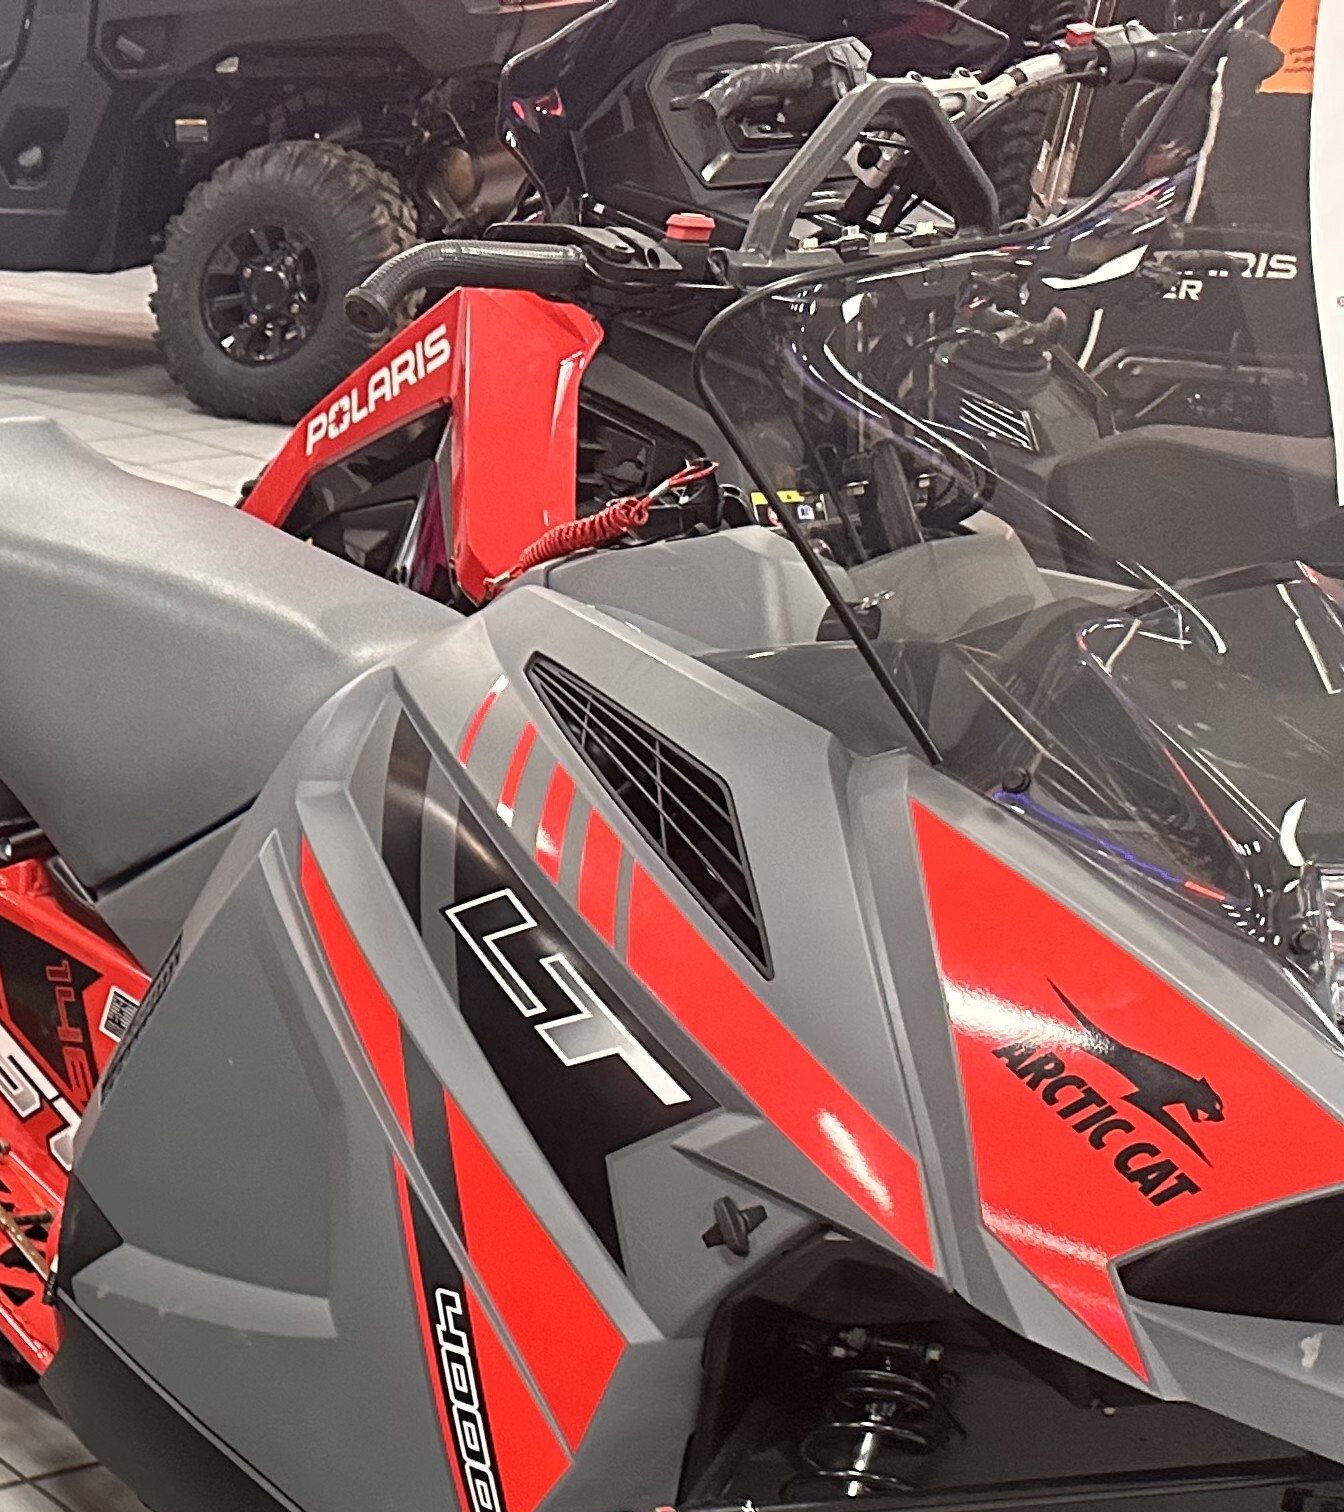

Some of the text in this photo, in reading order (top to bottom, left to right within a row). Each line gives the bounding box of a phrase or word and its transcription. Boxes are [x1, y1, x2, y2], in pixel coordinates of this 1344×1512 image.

[305, 322, 451, 457] POLARIS
[445, 888, 692, 1107] LT
[992, 1042, 1202, 1207] ARCTIC CAT
